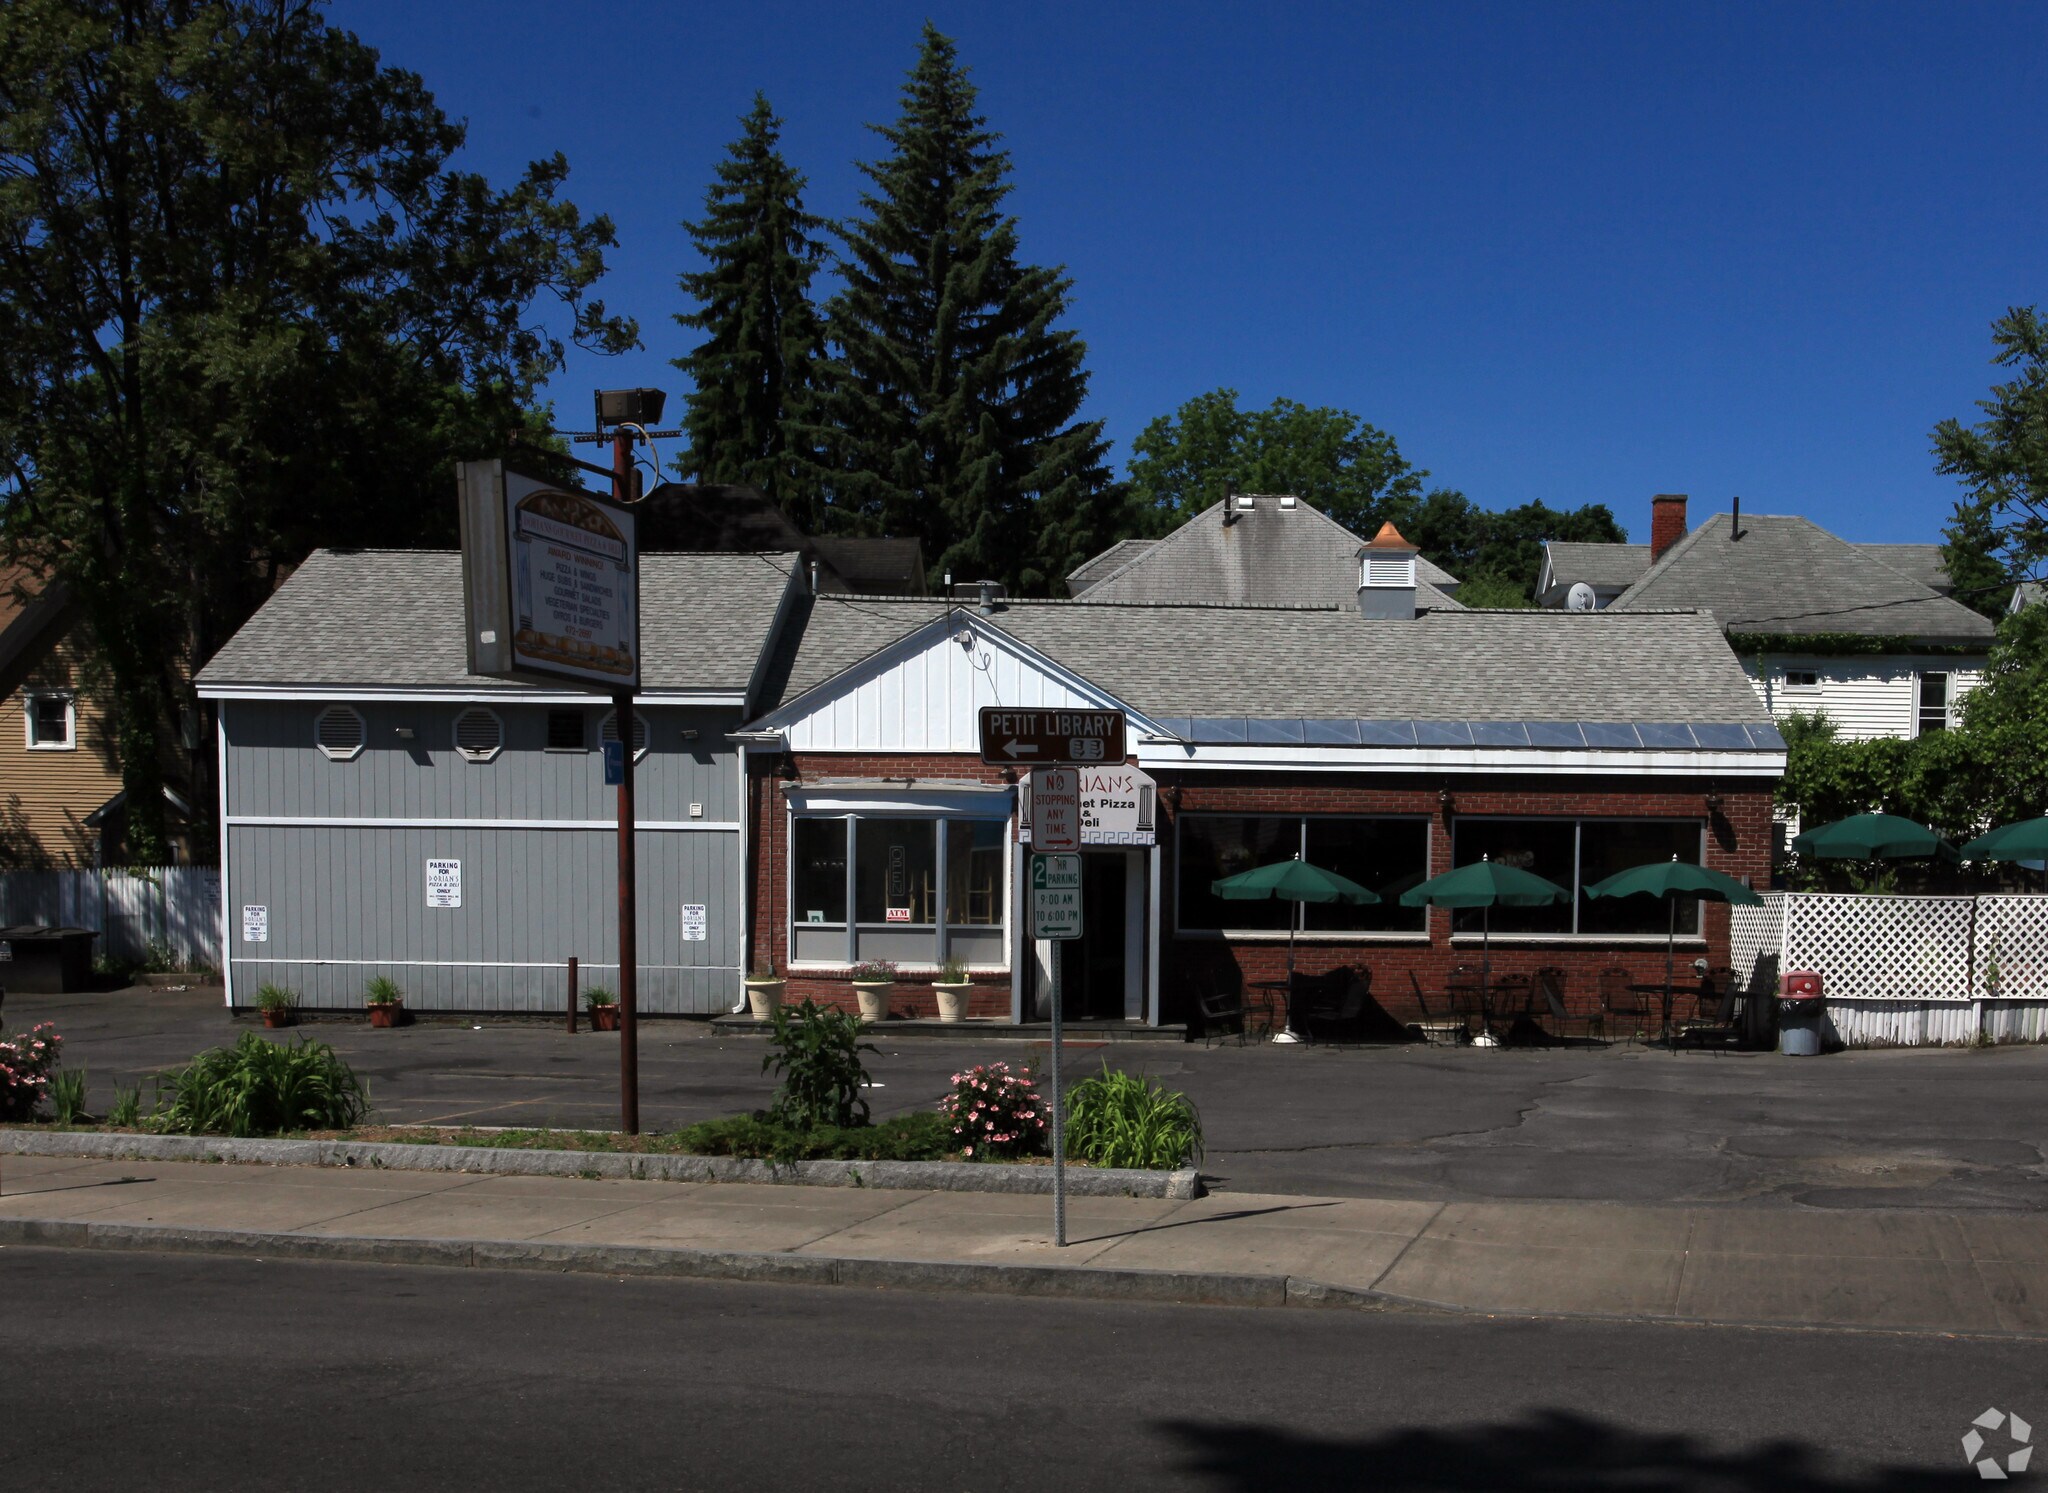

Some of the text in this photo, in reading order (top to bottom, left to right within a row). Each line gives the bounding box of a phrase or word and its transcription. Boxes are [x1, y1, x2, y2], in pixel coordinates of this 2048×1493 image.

[548, 546, 571, 560] AWARD
[556, 563, 597, 582] PIZZA & WINGS
[540, 570, 555, 582] HUGE
[557, 574, 572, 586] SUBS
[580, 580, 613, 598] SANDWICHES
[582, 593, 602, 606] SALADS
[553, 610, 603, 630] GYROS & BURGERS
[991, 714, 1115, 736] PETIT LIBRARY
[1047, 775, 1064, 790] NO
[1036, 794, 1075, 806] STOPPING
[1080, 799, 1135, 808] et Pizza
[1047, 809, 1064, 820] ANY
[1046, 824, 1066, 834] TIME
[892, 848, 902, 894] OPEN
[1035, 860, 1067, 883] 2 HR
[1048, 873, 1078, 884] PARKING
[1041, 895, 1072, 905] 9:00 AM
[1036, 911, 1078, 921] TO 6:00 PM
